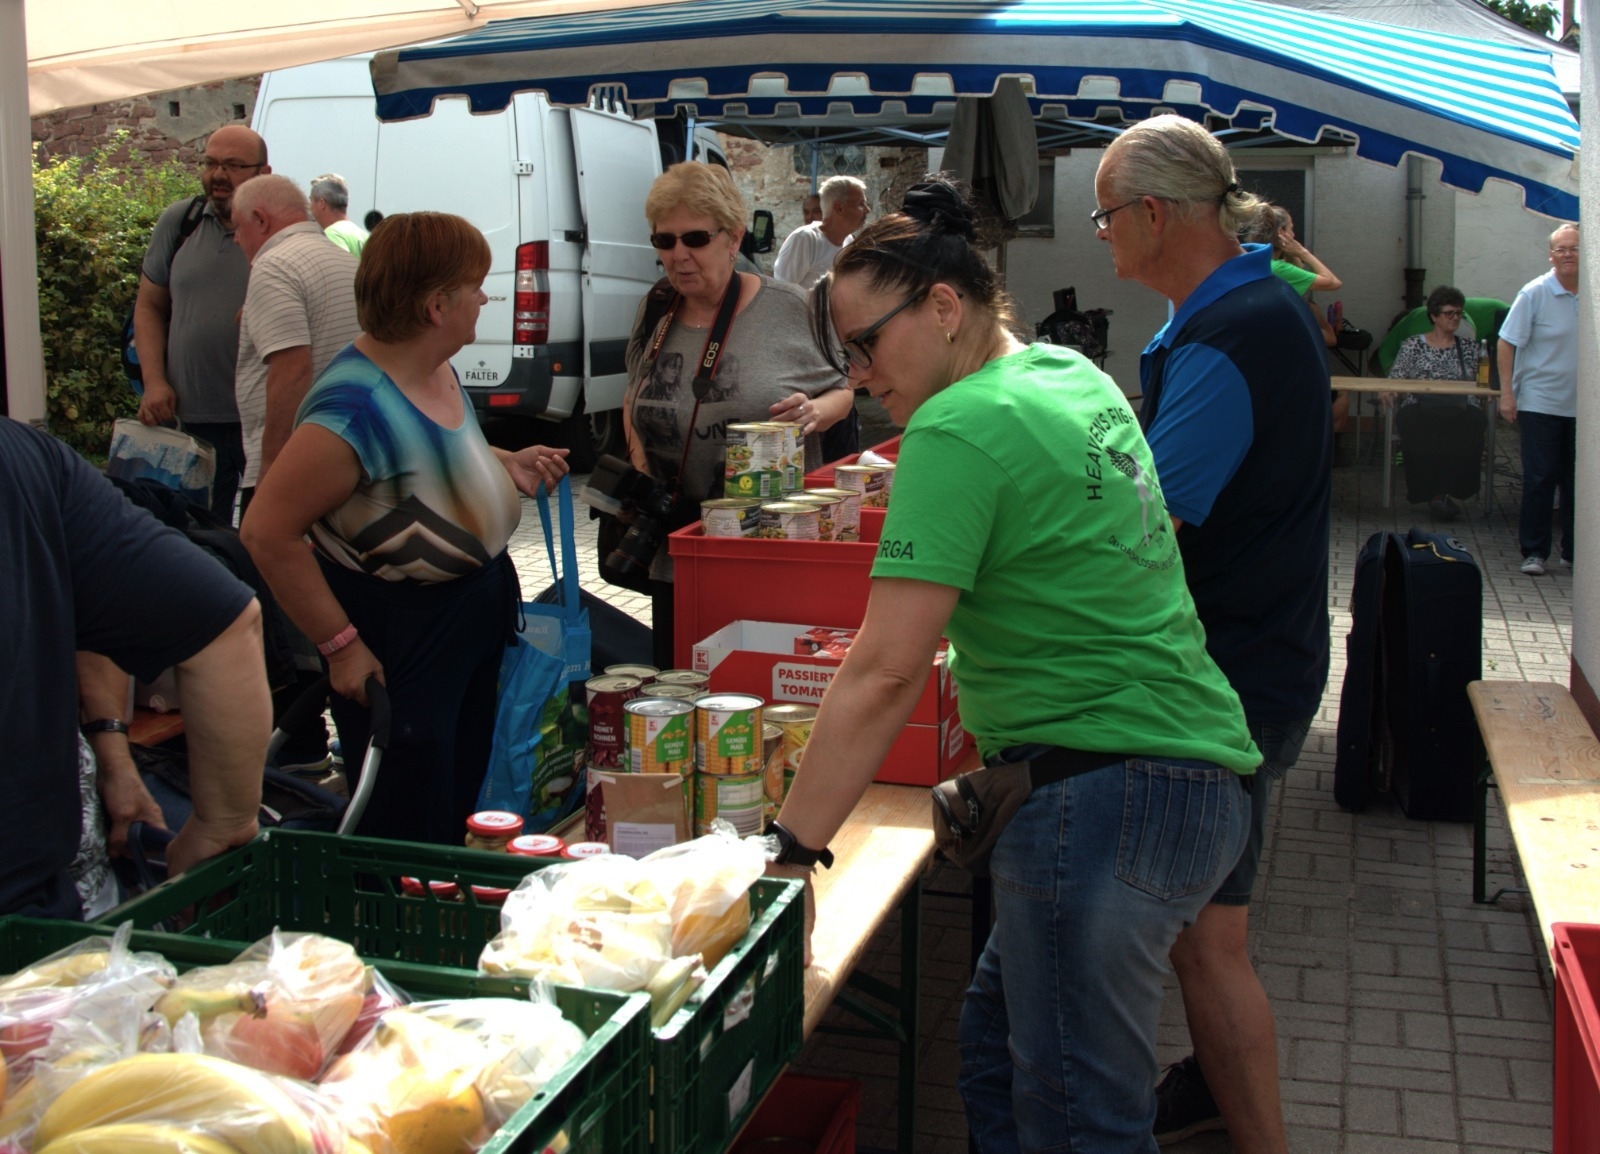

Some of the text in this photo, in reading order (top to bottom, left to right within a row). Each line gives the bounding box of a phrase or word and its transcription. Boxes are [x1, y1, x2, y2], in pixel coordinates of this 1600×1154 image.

[703, 341, 719, 367] EOS
[466, 371, 498, 380] FALTER
[1085, 412, 1111, 500] HEAVENS
[877, 540, 914, 560] RGA
[593, 725, 614, 734] KIDNEY
[593, 733, 616, 742] BOHNEN
